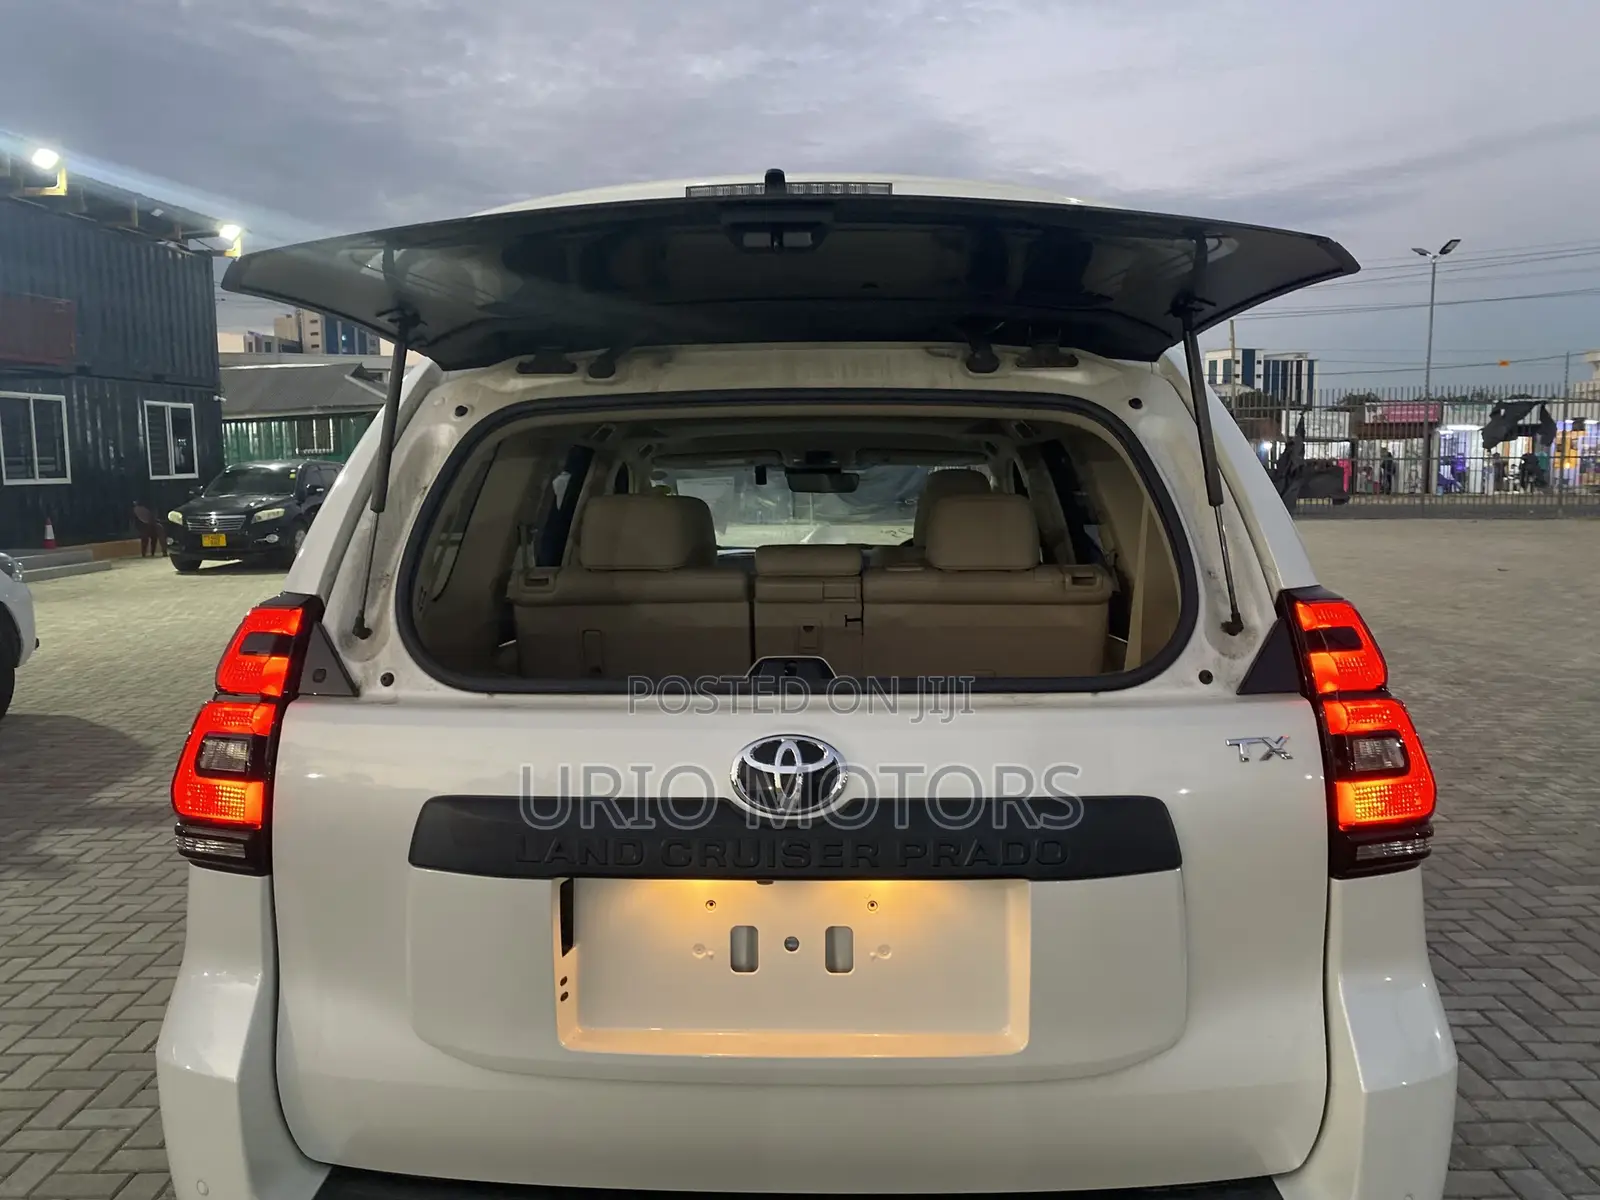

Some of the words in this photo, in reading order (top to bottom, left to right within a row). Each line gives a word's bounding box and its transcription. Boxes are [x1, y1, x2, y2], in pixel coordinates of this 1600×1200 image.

[1225, 735, 1293, 762] TX
[515, 834, 644, 866] LAND
[660, 837, 880, 868] CRUISER
[897, 838, 1068, 868] PRADO
